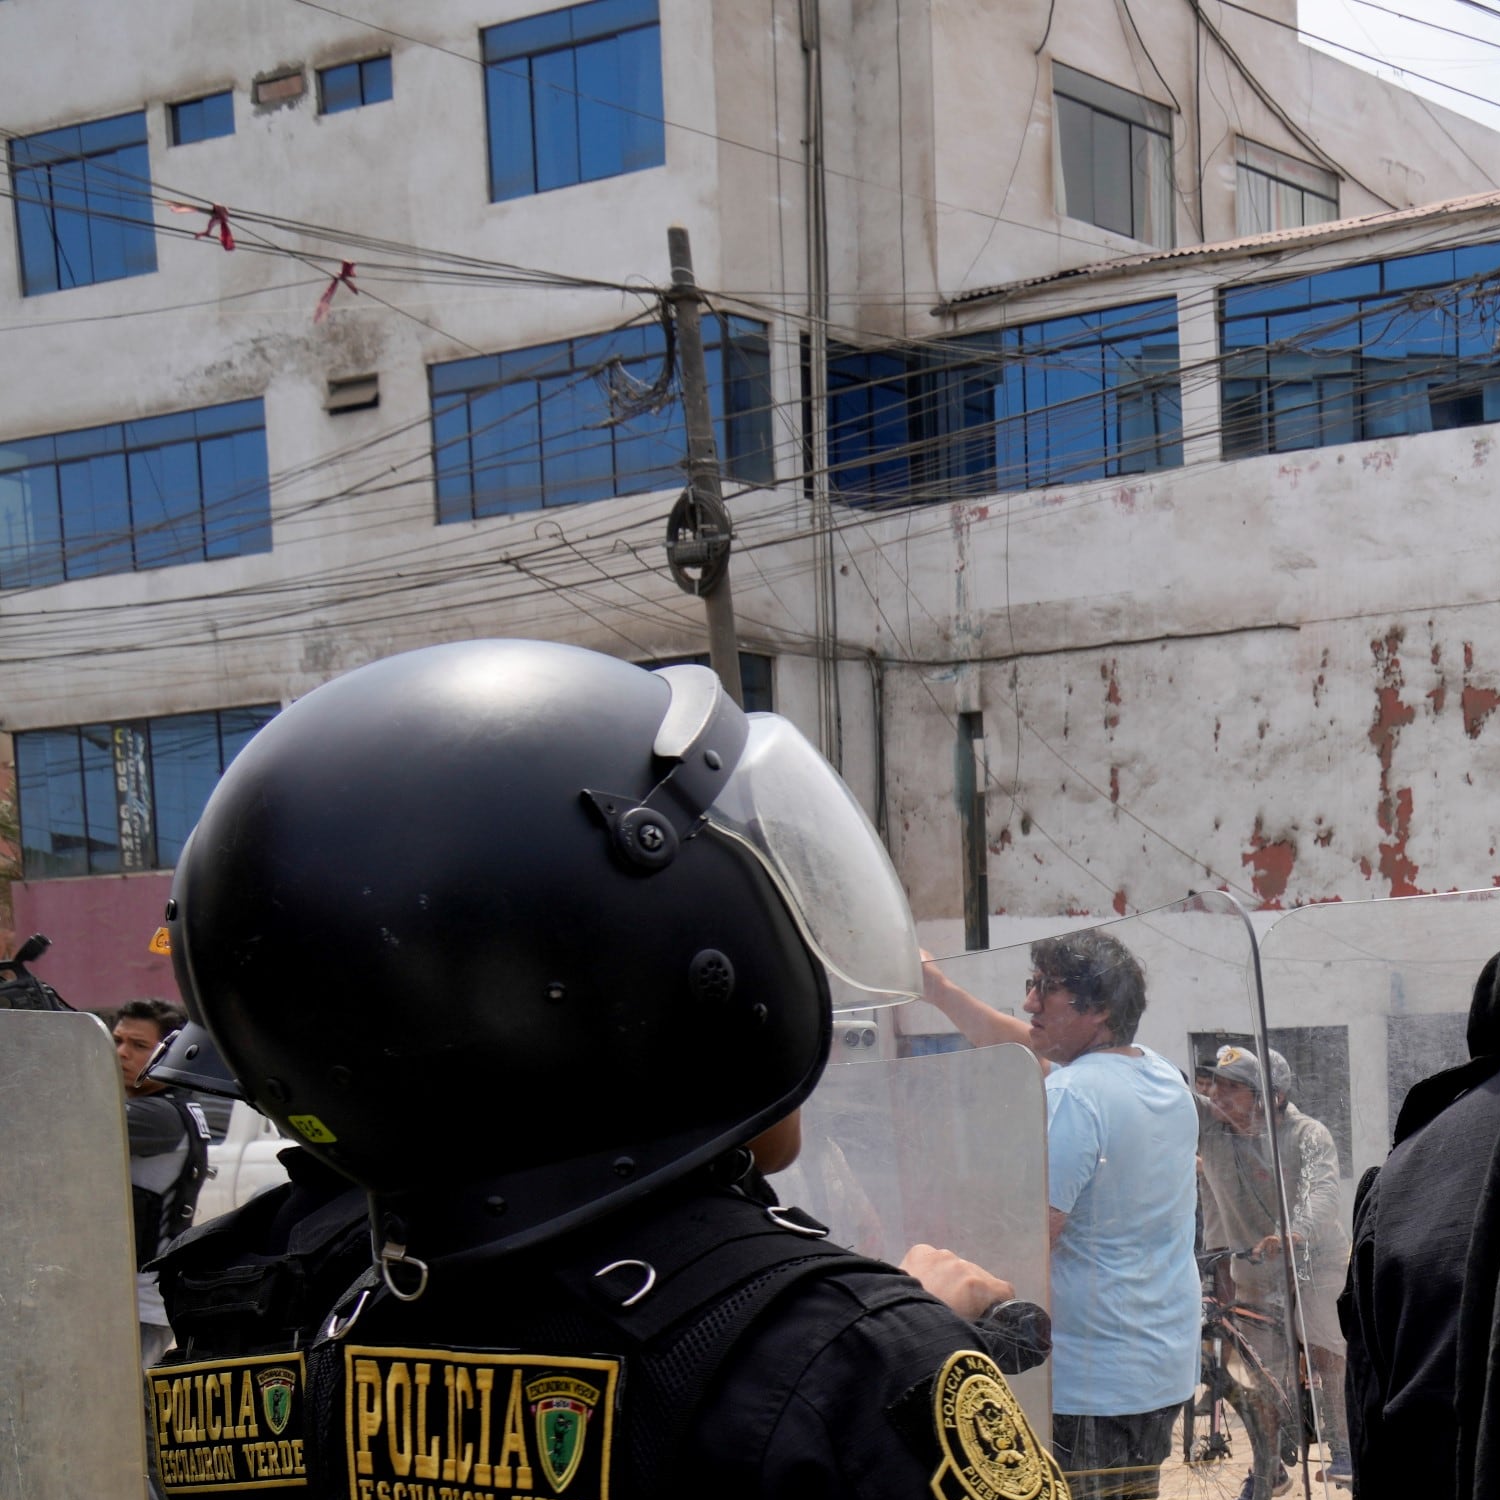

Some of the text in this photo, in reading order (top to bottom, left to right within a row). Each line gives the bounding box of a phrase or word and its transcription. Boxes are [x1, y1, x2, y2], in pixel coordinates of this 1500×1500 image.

[114, 728, 134, 867] CLUB GAME
[155, 1369, 259, 1446] POLICIA
[355, 1359, 533, 1490] POLICIA
[943, 1363, 965, 1429] POLICIA
[160, 1439, 306, 1484] ESCUADRON VERDE
